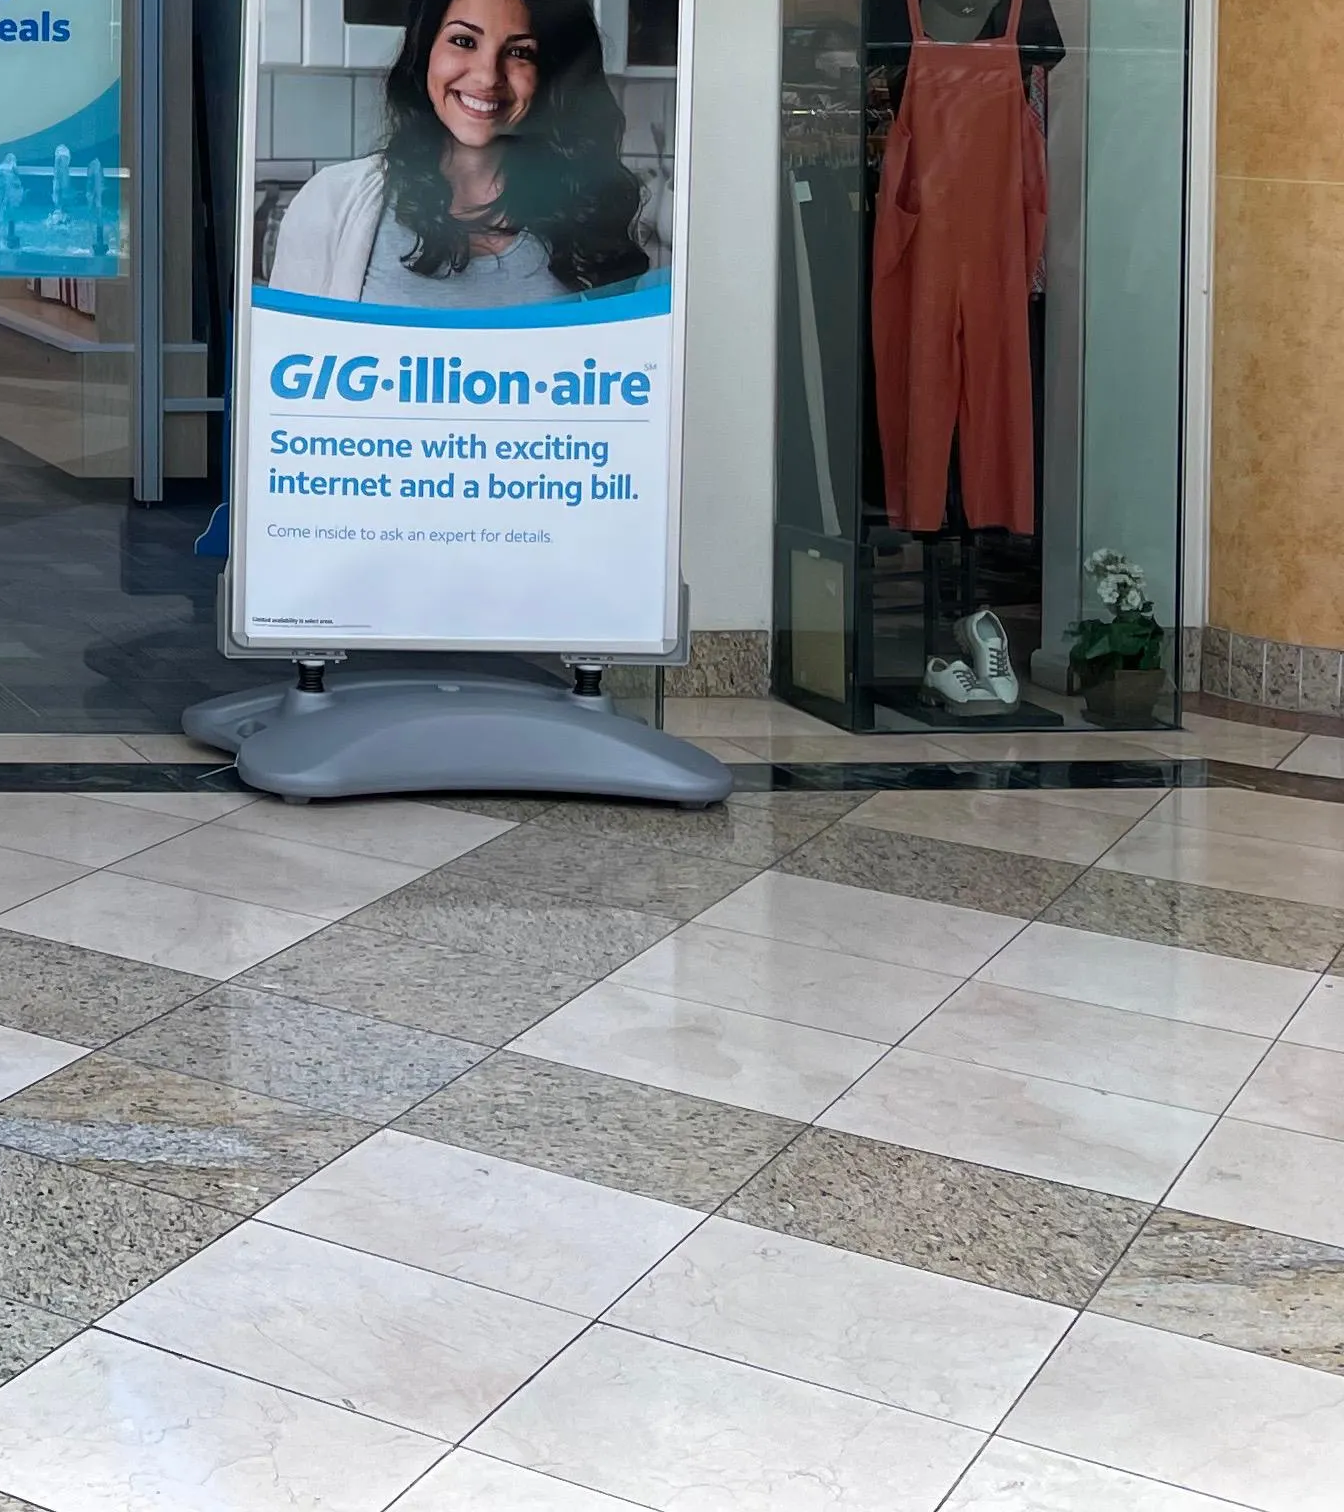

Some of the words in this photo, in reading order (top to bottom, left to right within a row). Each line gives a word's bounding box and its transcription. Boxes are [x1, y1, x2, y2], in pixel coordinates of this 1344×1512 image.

[269, 429, 413, 459] Someone
[421, 432, 487, 460] with
[494, 434, 609, 468] exciting
[268, 467, 392, 498] internet
[399, 473, 454, 499] and
[462, 478, 480, 500] a
[488, 473, 583, 507] boring
[590, 473, 639, 501] bill.
[267, 523, 311, 539] Come
[314, 525, 357, 541] inside
[360, 527, 376, 541] to
[379, 527, 404, 542] ask
[407, 530, 425, 542] an
[429, 528, 477, 546] expert
[480, 527, 502, 543] for
[504, 528, 554, 545] details.
